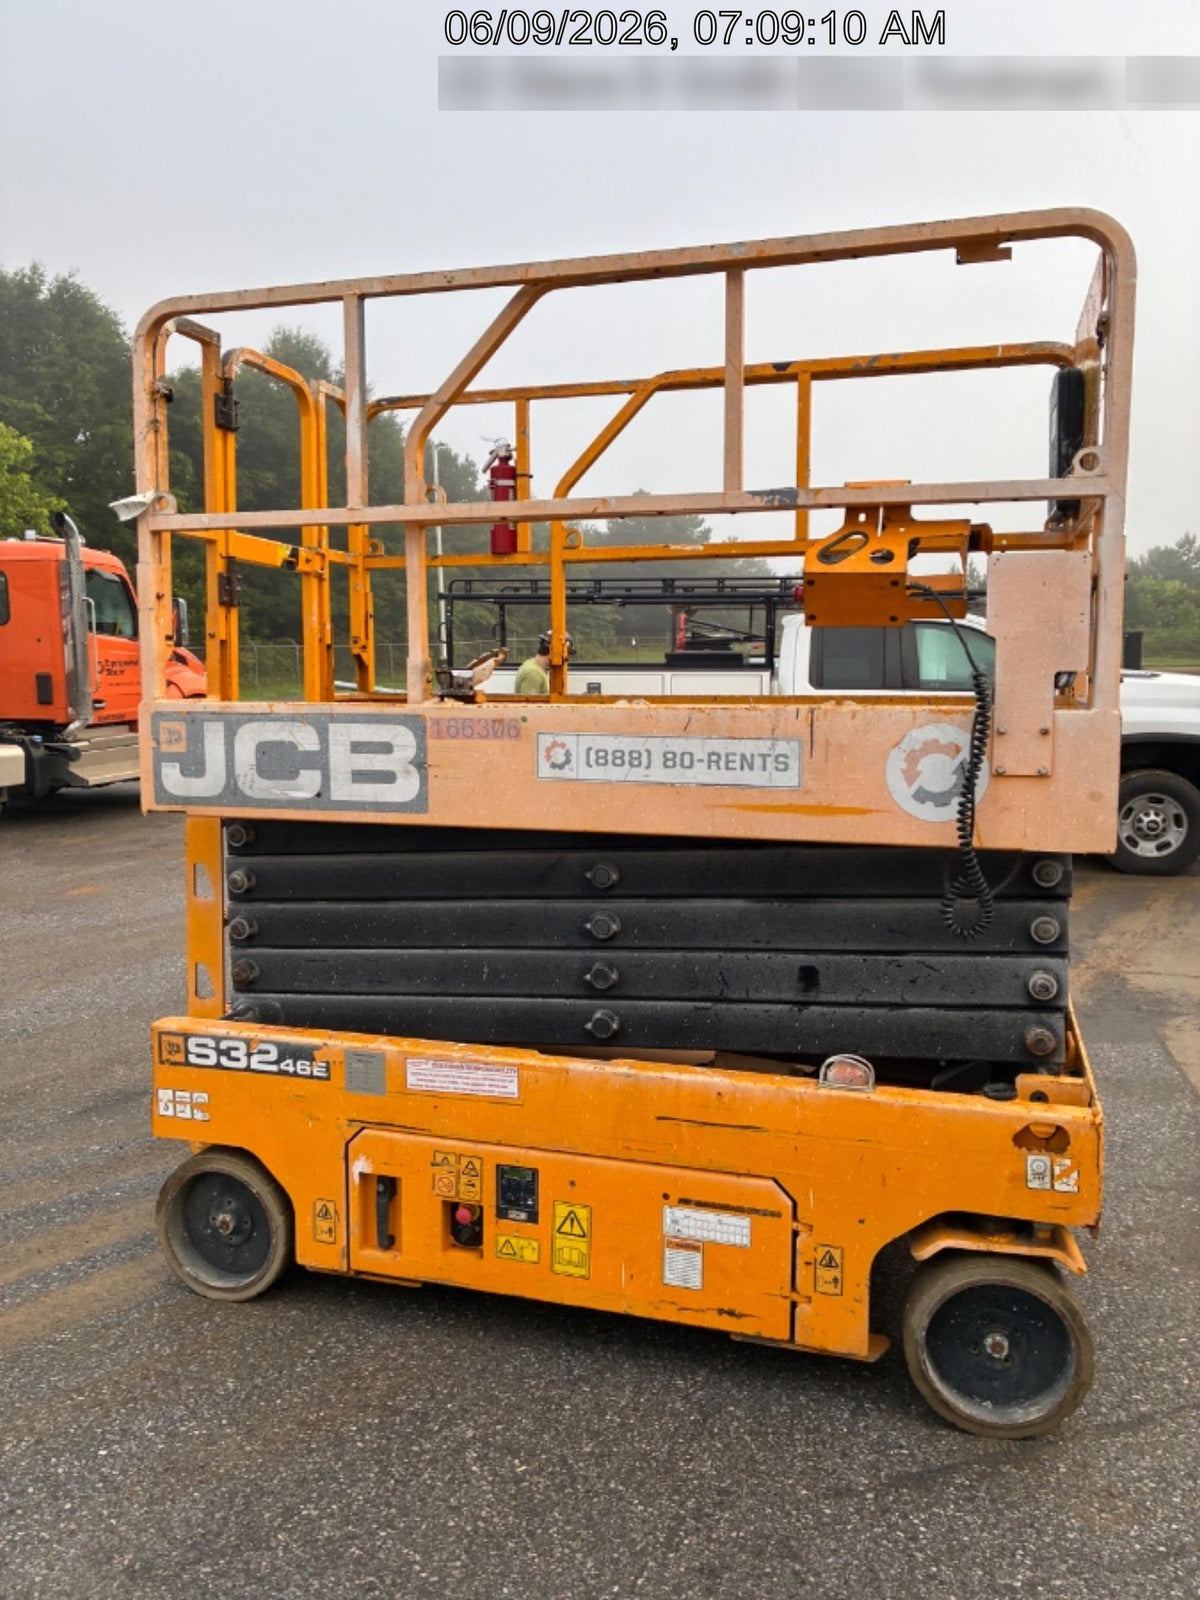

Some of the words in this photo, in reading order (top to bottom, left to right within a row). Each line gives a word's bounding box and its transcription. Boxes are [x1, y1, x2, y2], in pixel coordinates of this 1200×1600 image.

[161, 721, 420, 802] JCB
[586, 746, 652, 770] (888)
[662, 750, 790, 773] 80-RENTS
